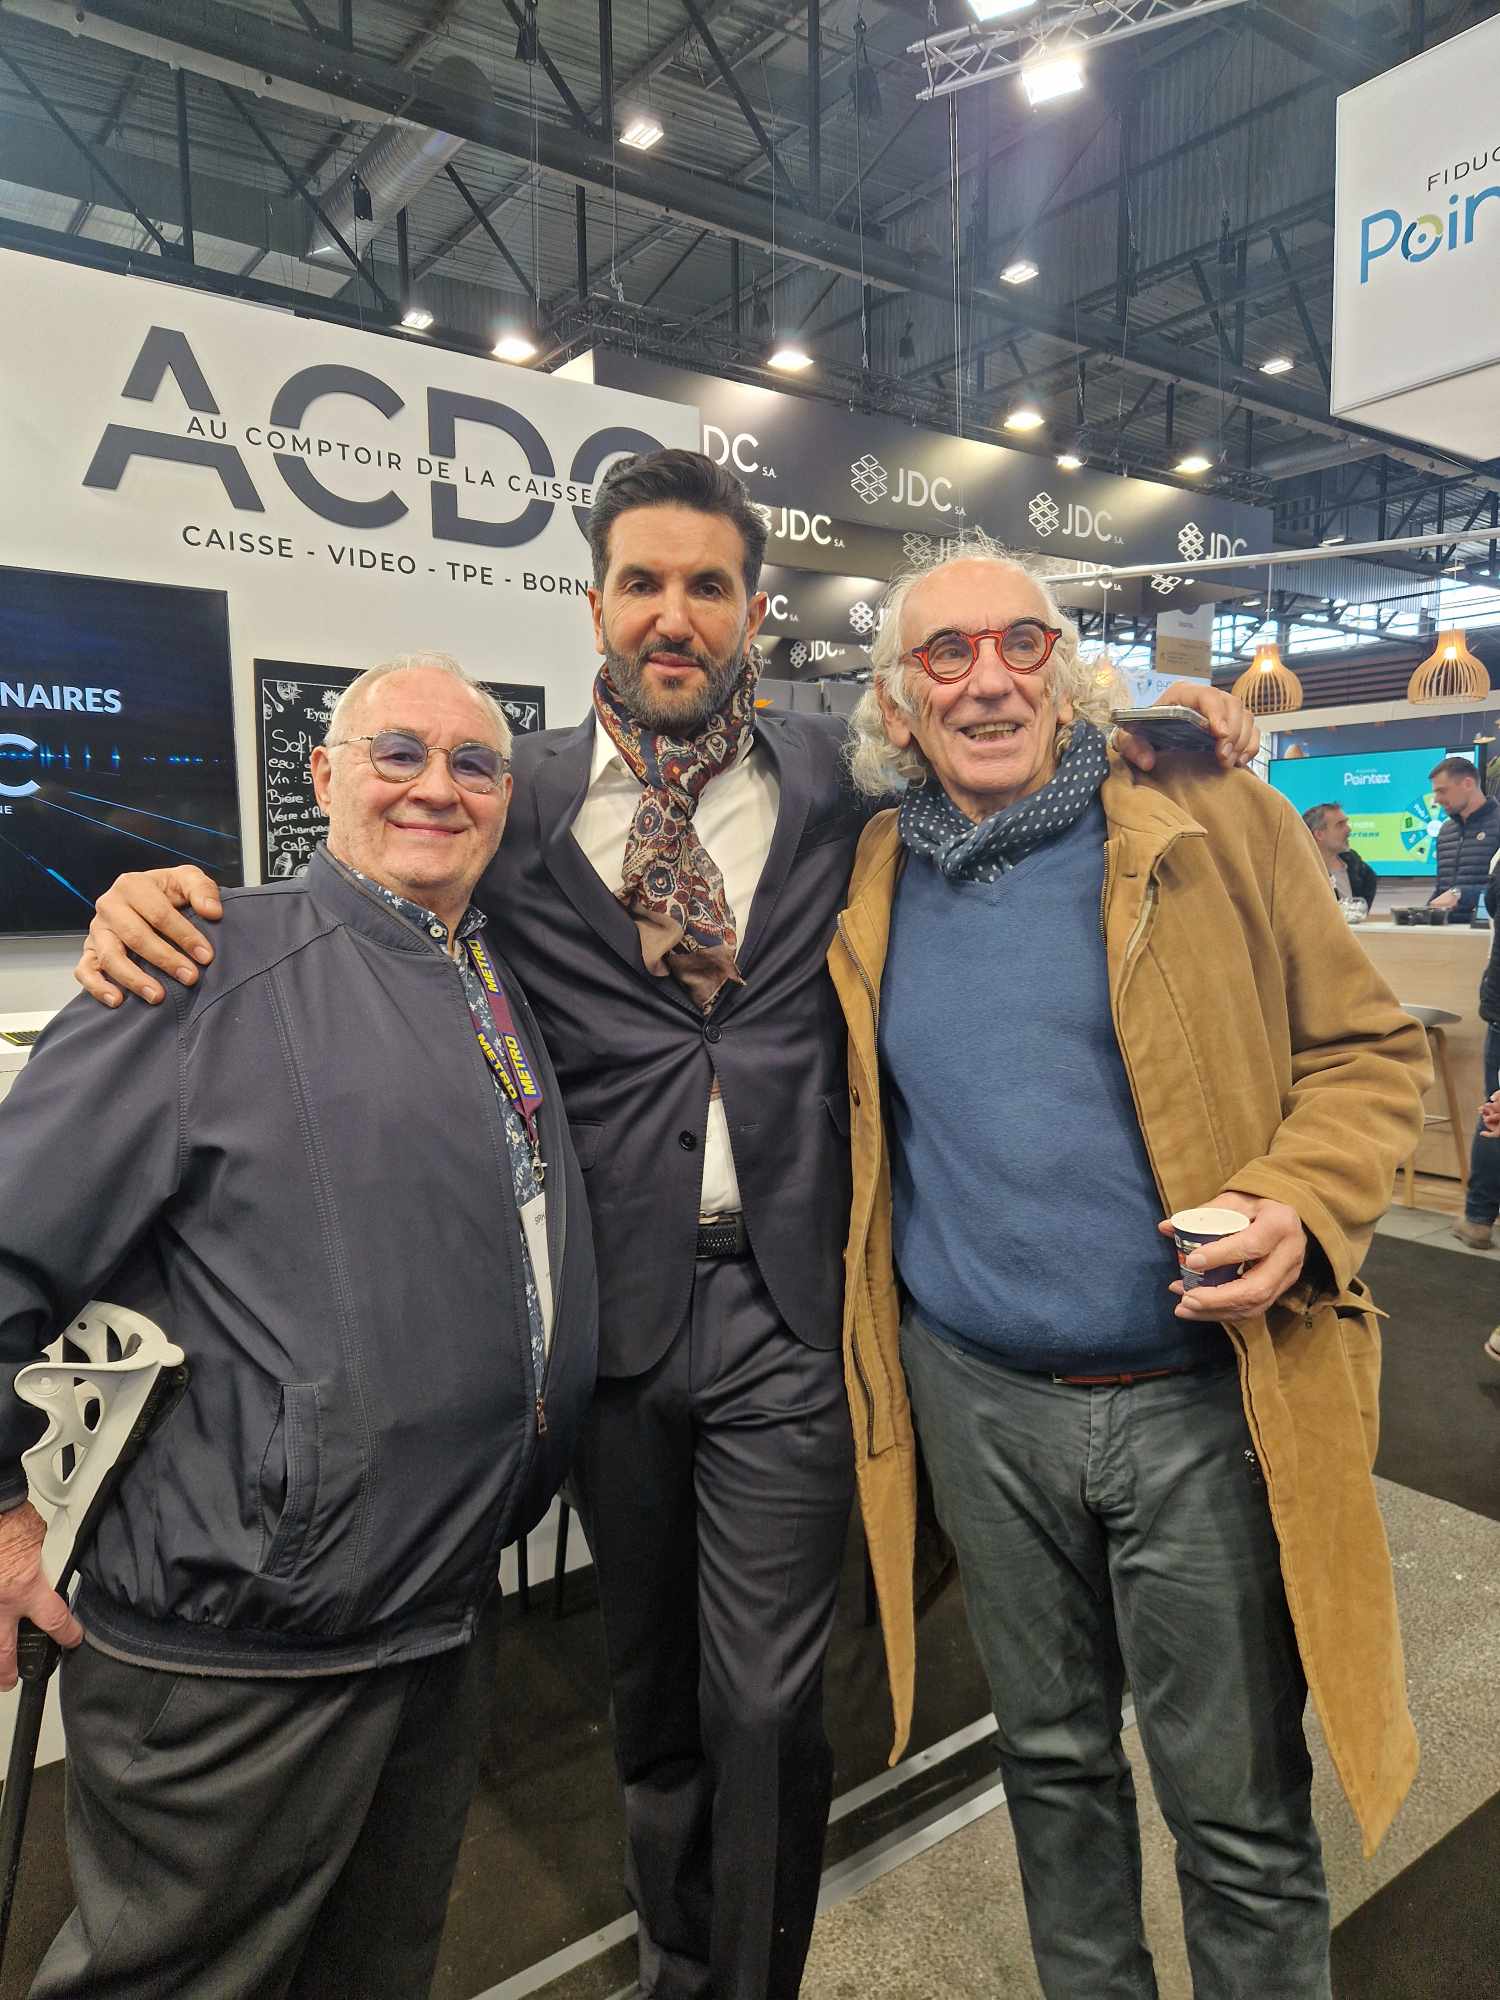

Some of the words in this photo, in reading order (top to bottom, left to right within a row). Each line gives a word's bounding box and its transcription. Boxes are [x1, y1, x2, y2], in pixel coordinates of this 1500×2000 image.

[187, 416, 227, 439] AU
[245, 427, 402, 472] COMPTOIR
[417, 457, 451, 479] DE
[465, 466, 495, 488] LA
[508, 474, 593, 505] CAISSE
[891, 468, 953, 512] JDC
[774, 508, 832, 545] JDC
[1062, 503, 1113, 542] JDC
[182, 525, 294, 558] CAISSE
[327, 544, 416, 574] VIDEO
[446, 562, 493, 585] TPE
[0, 681, 122, 714] NAIRES
[268, 771, 290, 785] Vin
[467, 939, 500, 993] METRO
[476, 1032, 518, 1100] METRO
[503, 1035, 537, 1096] METRO
